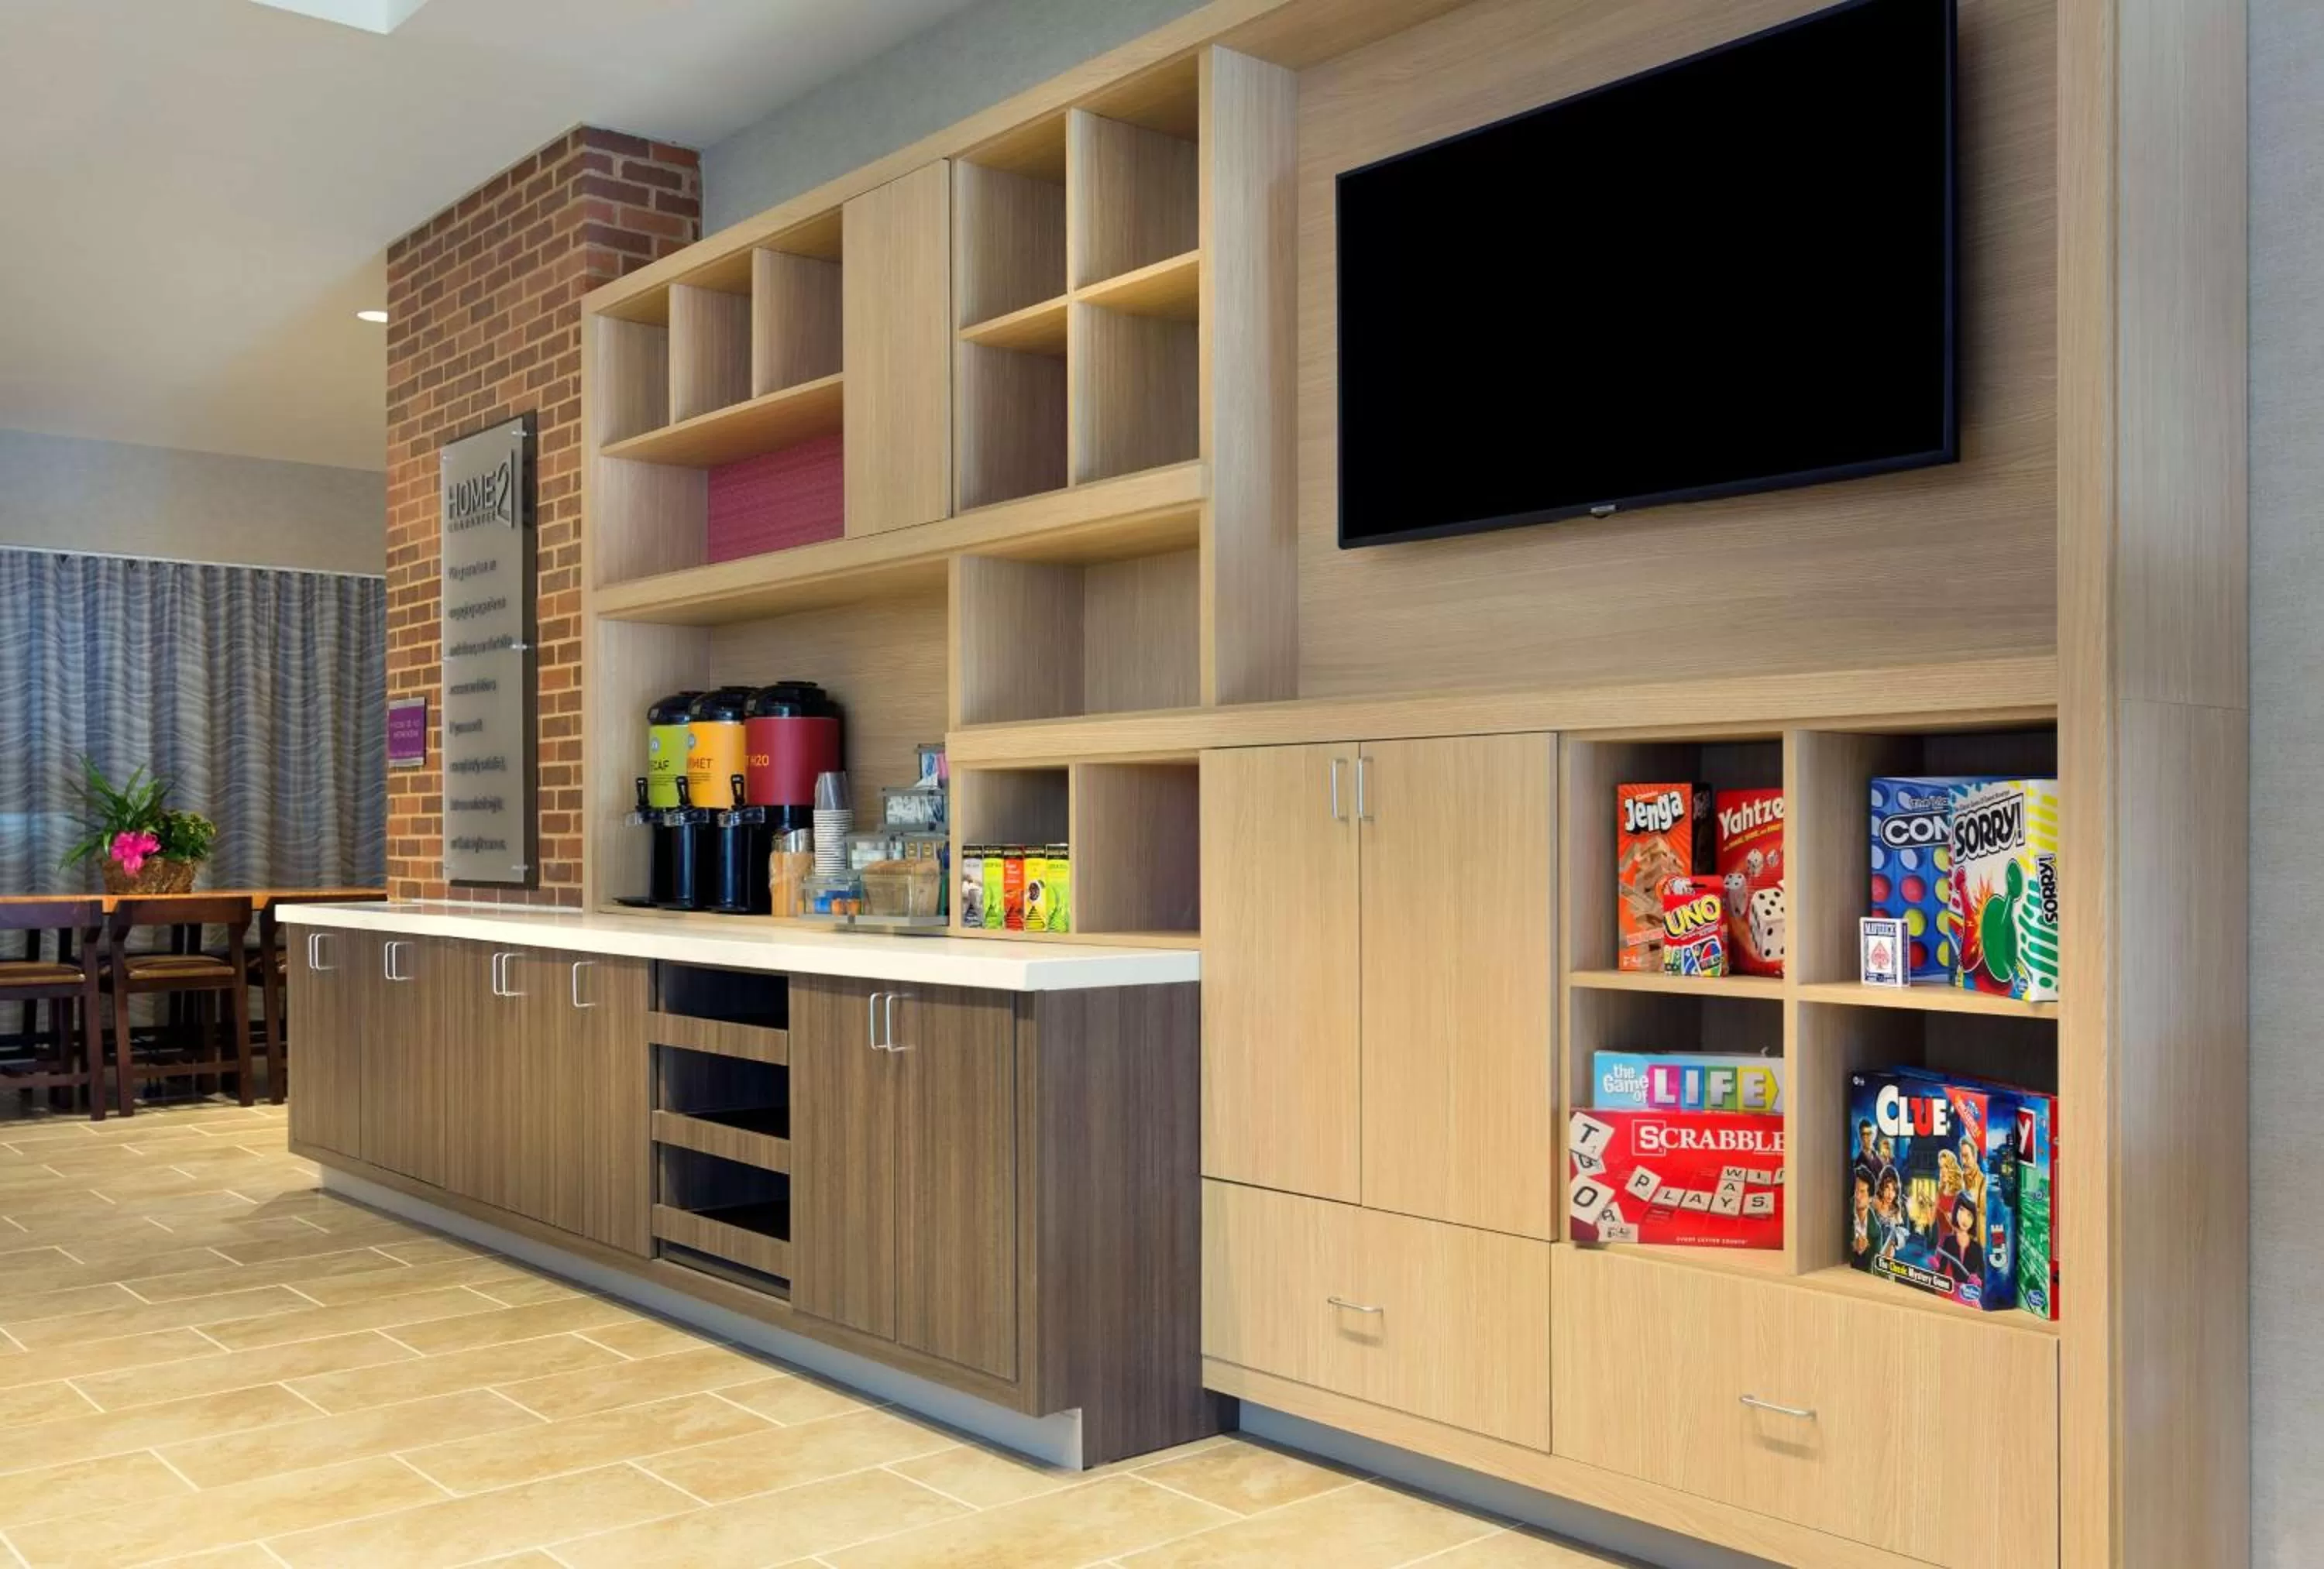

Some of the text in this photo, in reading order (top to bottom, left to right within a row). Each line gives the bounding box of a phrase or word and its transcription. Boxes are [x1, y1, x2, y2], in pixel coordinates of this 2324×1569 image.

[1624, 791, 1685, 832] Jenga
[1954, 802, 2021, 857] SORRY!
[1665, 894, 1721, 937] UNO
[1603, 1073, 1648, 1093] Game
[1614, 1064, 1635, 1080] the
[1654, 1069, 1766, 1107] LIFE
[1633, 1090, 1648, 1104] of
[1875, 1084, 1948, 1137] CLUE
[1989, 1224, 2008, 1268] CLUE
